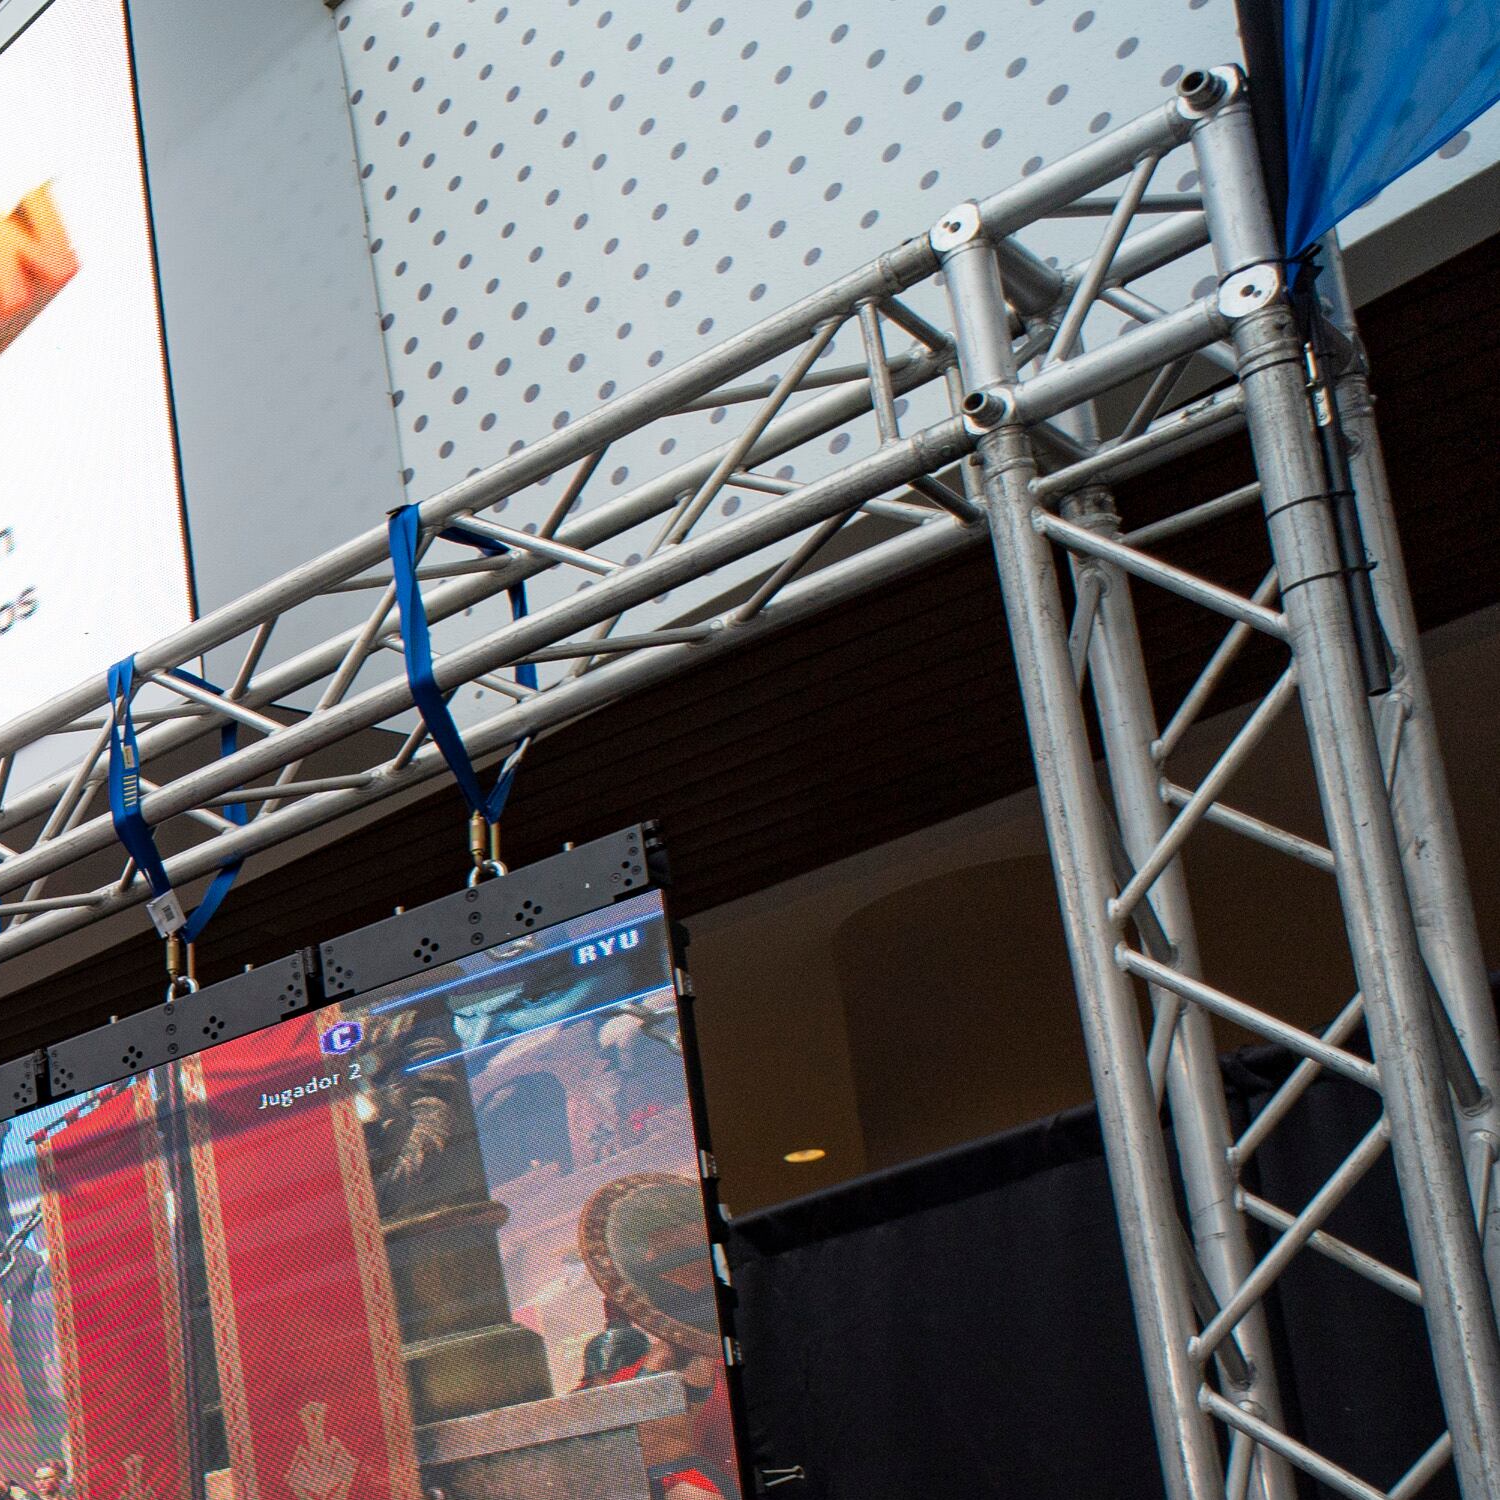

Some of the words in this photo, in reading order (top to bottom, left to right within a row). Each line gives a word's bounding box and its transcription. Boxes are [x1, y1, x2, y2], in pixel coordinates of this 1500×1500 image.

[574, 929, 640, 966] RYU
[258, 1073, 340, 1110] Jugador
[348, 1063, 363, 1081] 2
